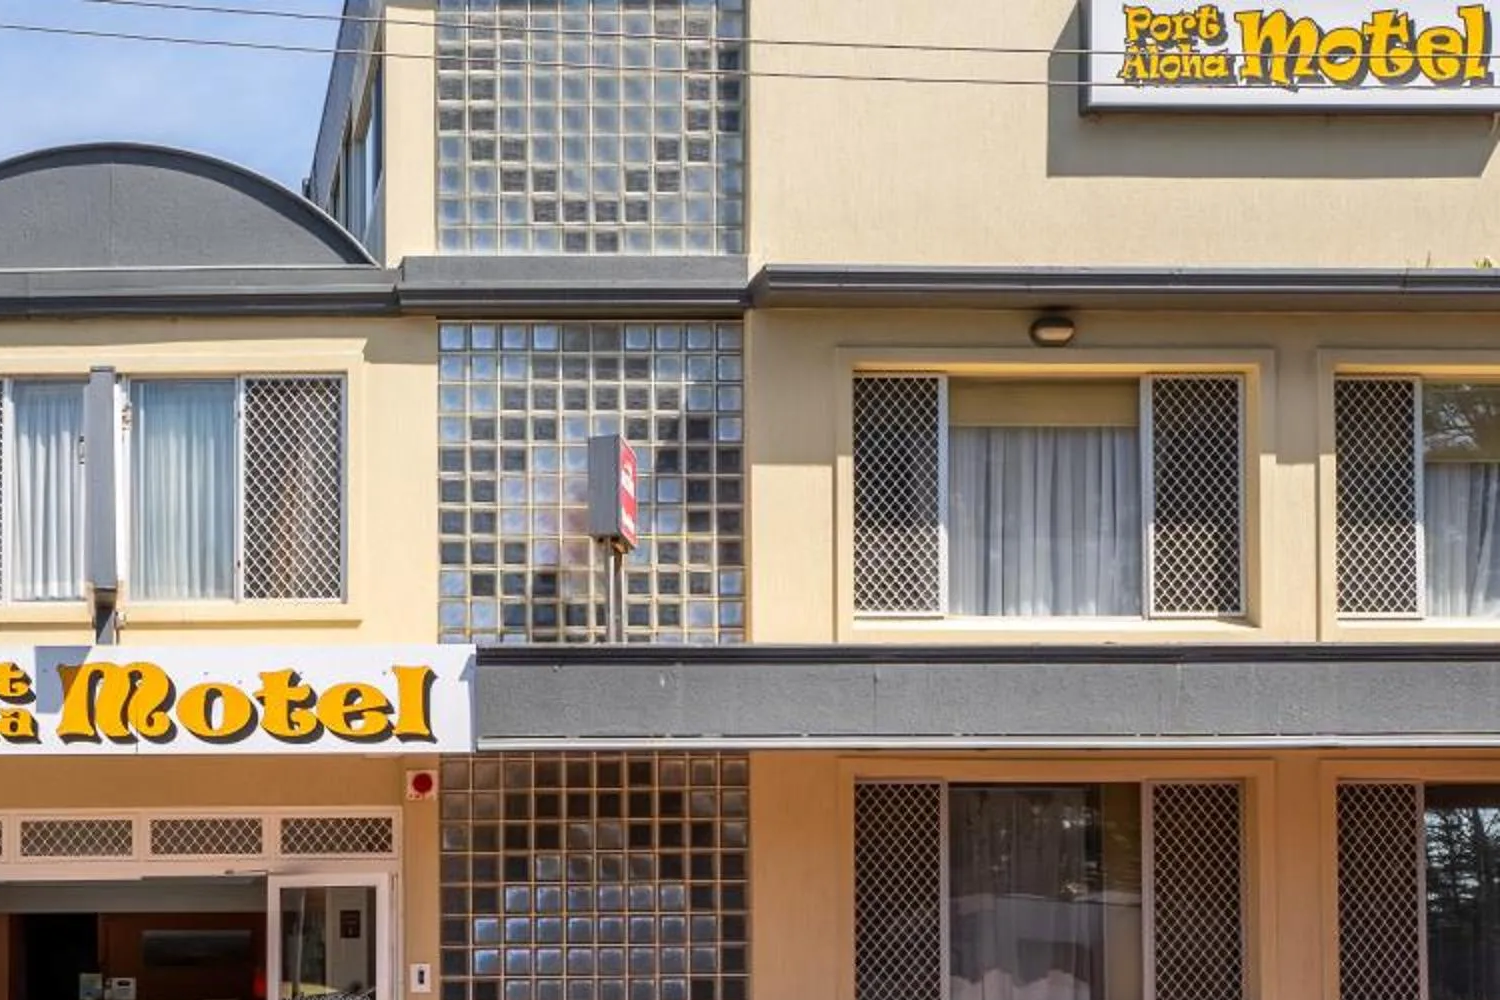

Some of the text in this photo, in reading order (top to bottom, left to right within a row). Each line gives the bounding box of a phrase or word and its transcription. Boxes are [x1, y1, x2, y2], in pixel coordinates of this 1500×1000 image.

[1123, 5, 1224, 43] Port
[1234, 3, 1488, 86] Motel
[1118, 43, 1231, 81] Aloha
[56, 660, 437, 744] Motel
